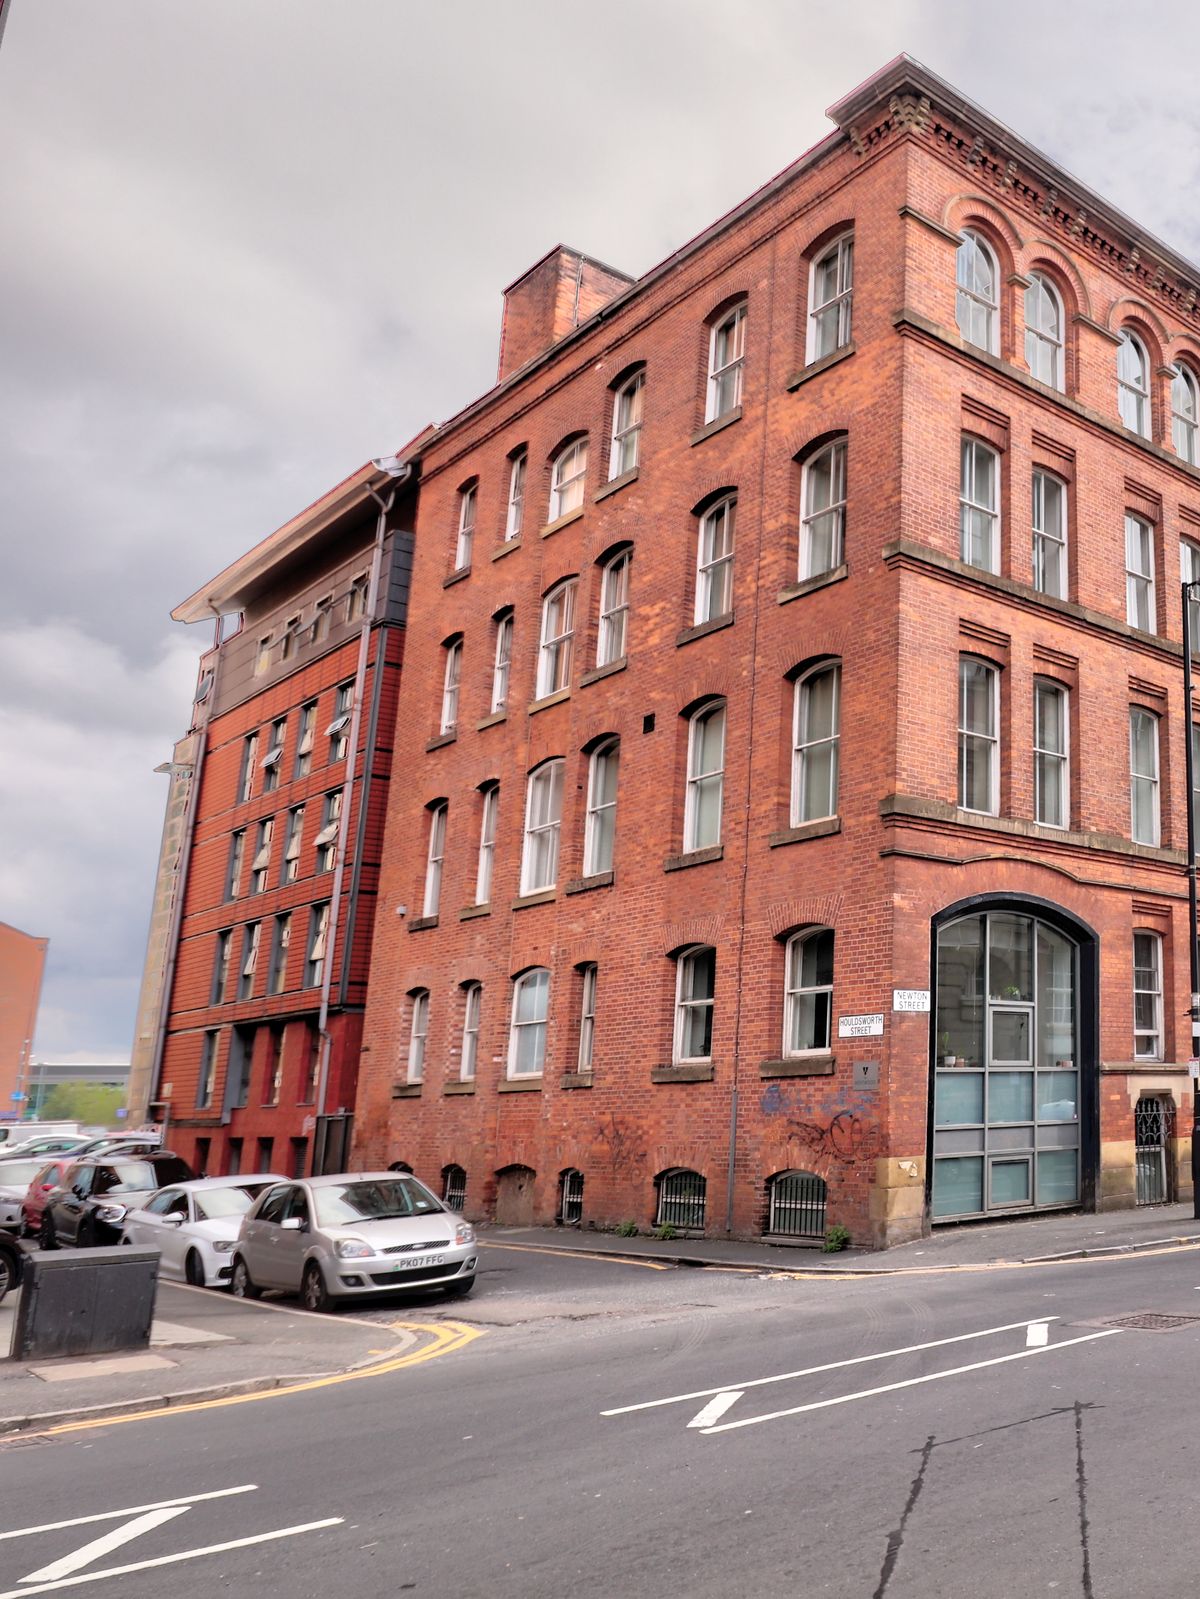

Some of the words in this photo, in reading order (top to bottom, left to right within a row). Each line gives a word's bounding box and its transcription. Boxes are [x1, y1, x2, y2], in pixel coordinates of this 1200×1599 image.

[897, 991, 928, 1001] NEWTON
[898, 1001, 925, 1010] STREET
[839, 1015, 883, 1027] HOULDSWORTH
[850, 1026, 872, 1035] STREET
[400, 1257, 426, 1268] PK07
